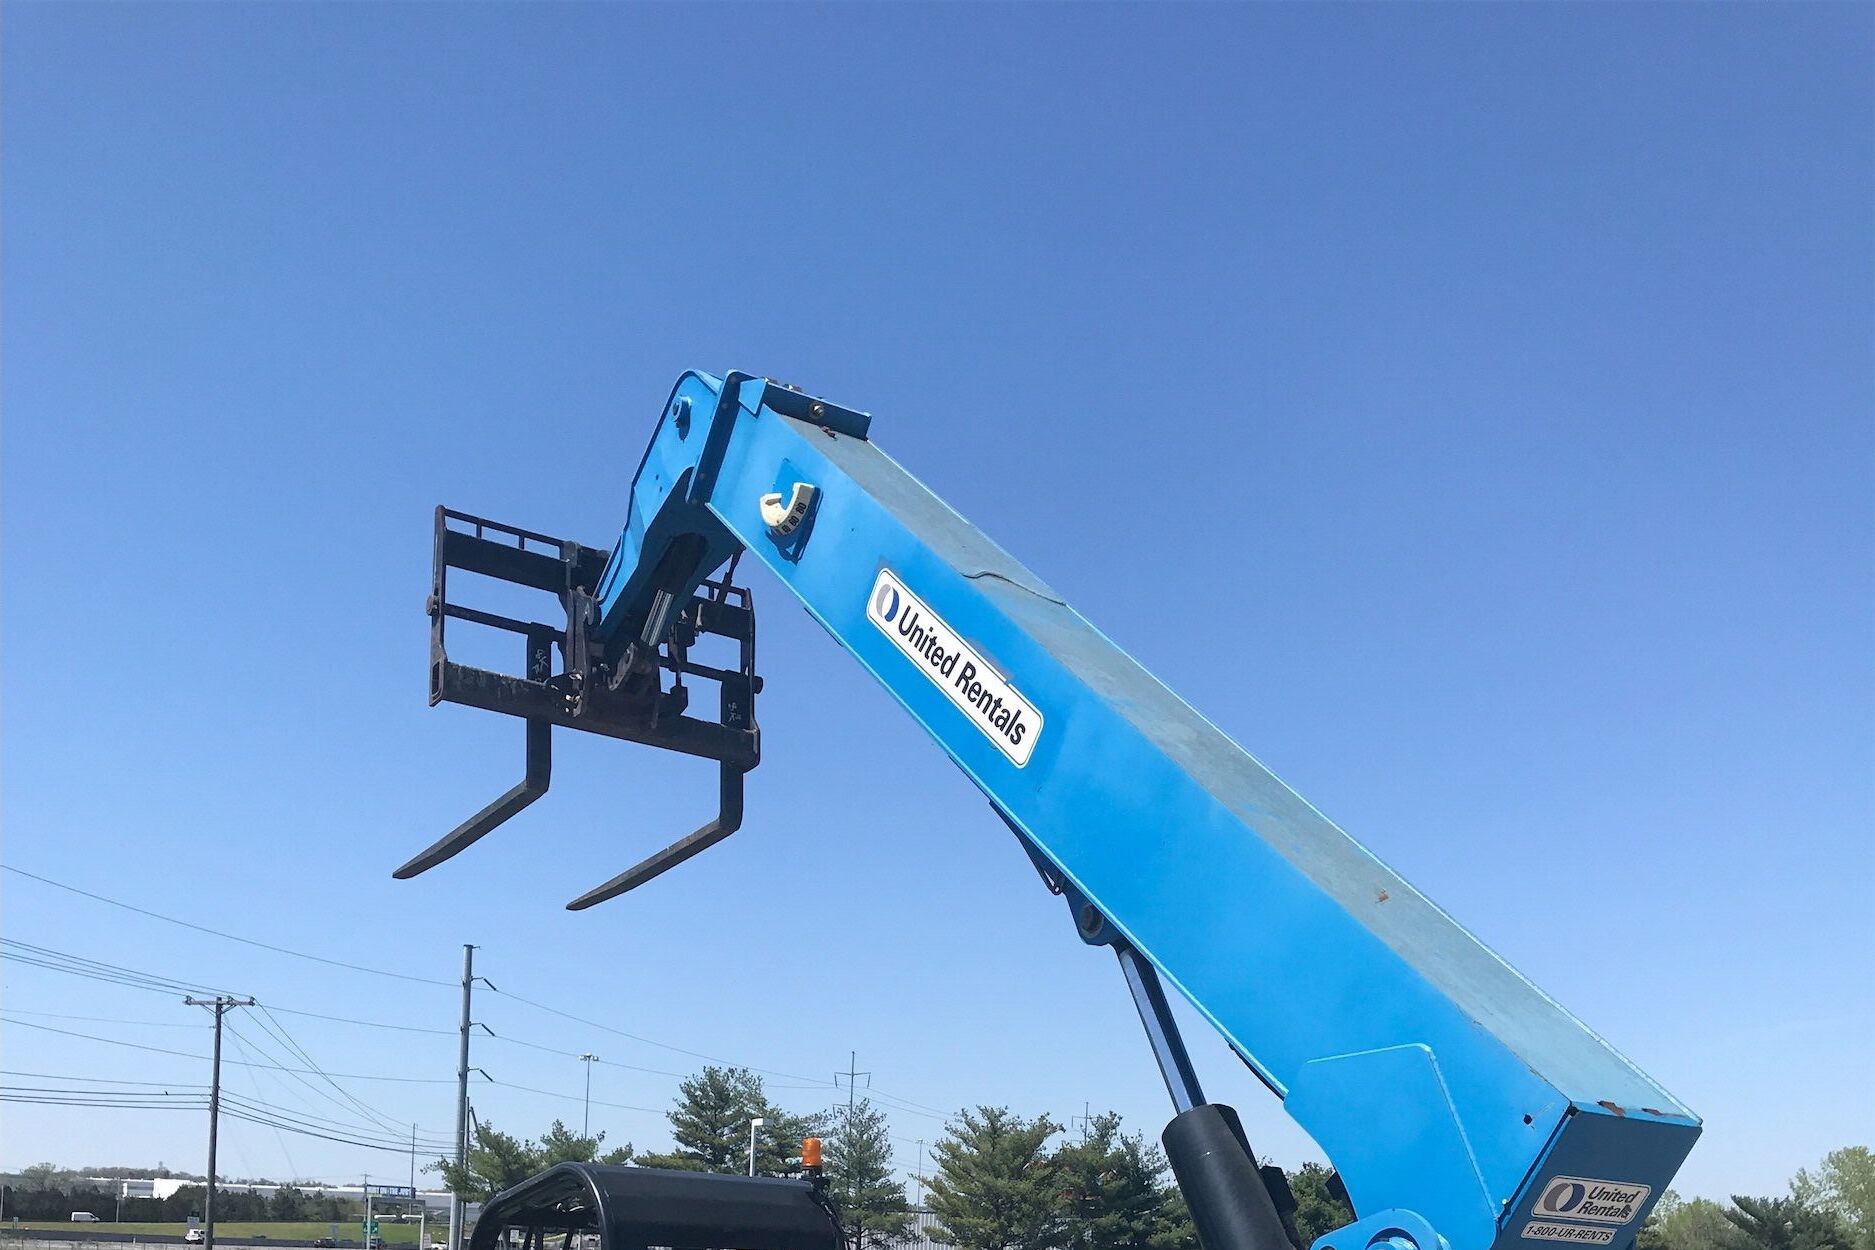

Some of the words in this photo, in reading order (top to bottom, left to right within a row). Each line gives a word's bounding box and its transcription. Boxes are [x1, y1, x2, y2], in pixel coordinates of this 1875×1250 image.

[898, 605, 960, 679] United
[954, 661, 1026, 746] Rentals
[1588, 1186, 1641, 1204] United
[1577, 1201, 1632, 1219] Rentals
[1526, 1225, 1614, 1242] 1-800-UR-RENTS
